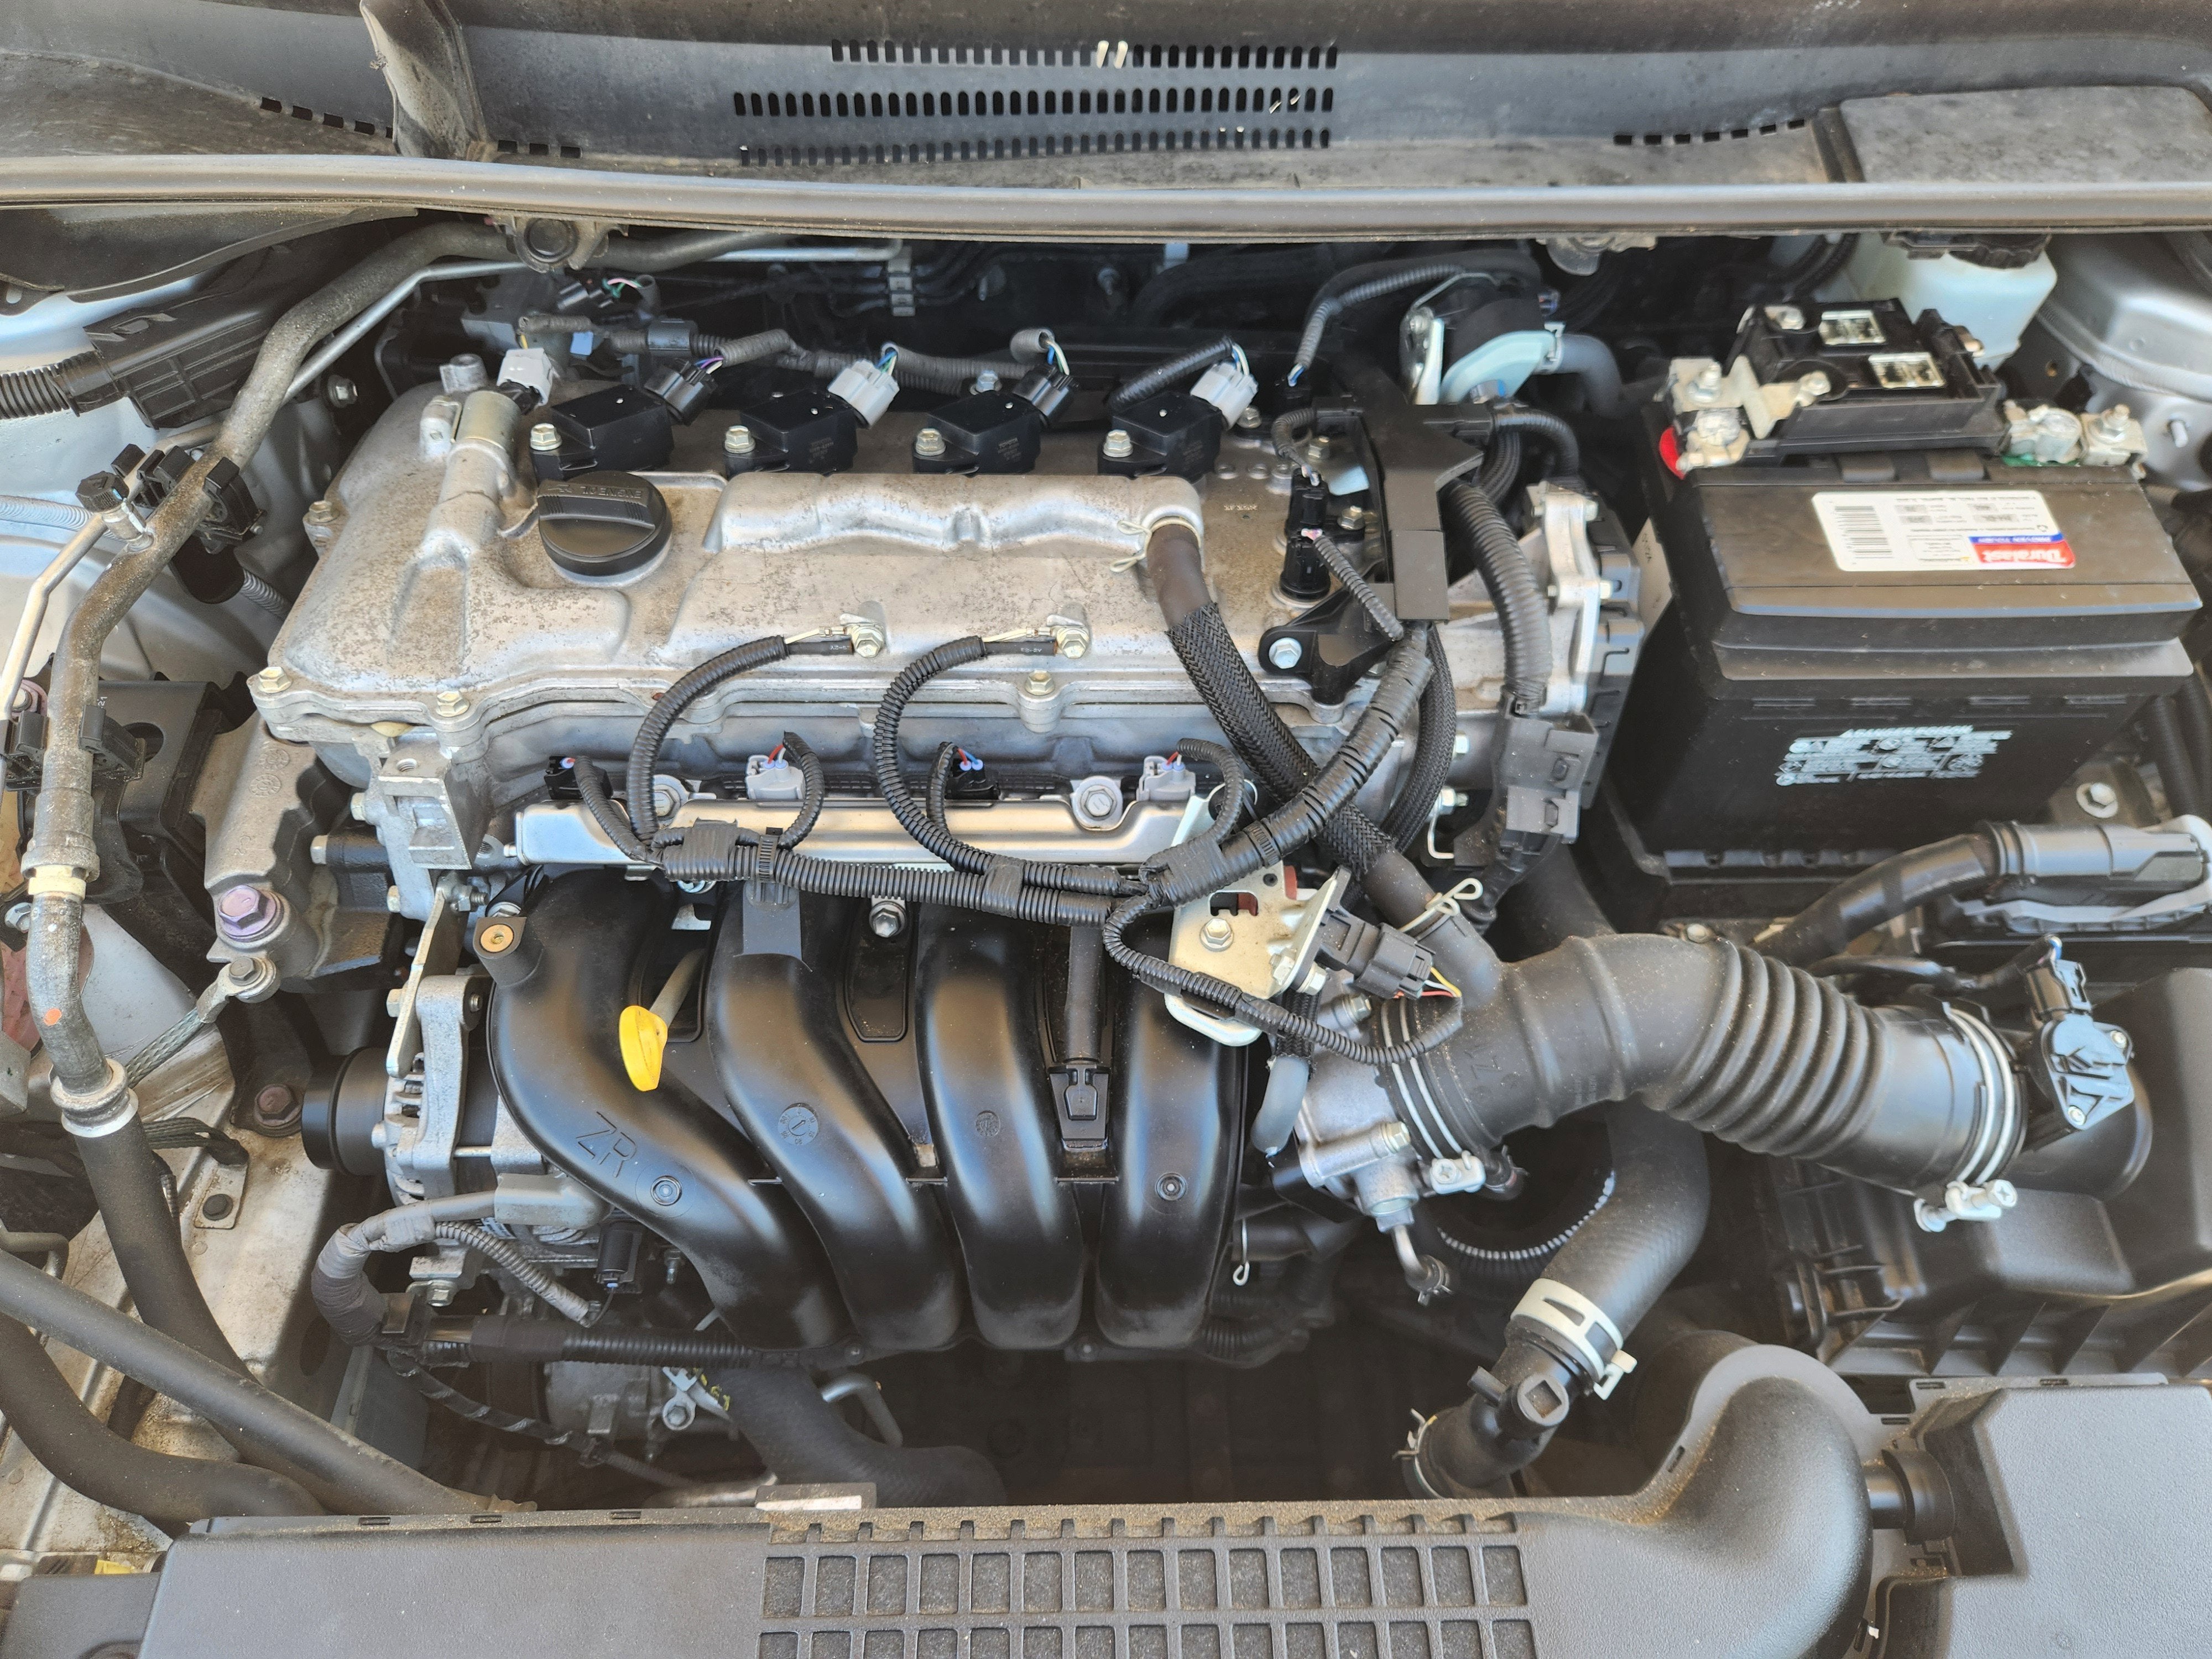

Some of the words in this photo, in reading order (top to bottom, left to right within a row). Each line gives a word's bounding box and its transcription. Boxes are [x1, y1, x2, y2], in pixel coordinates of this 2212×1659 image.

[580, 486, 596, 495] OIL
[598, 487, 641, 498] ENGINE
[1982, 549, 2067, 563] Duralast
[576, 1110, 637, 1178] ZR
